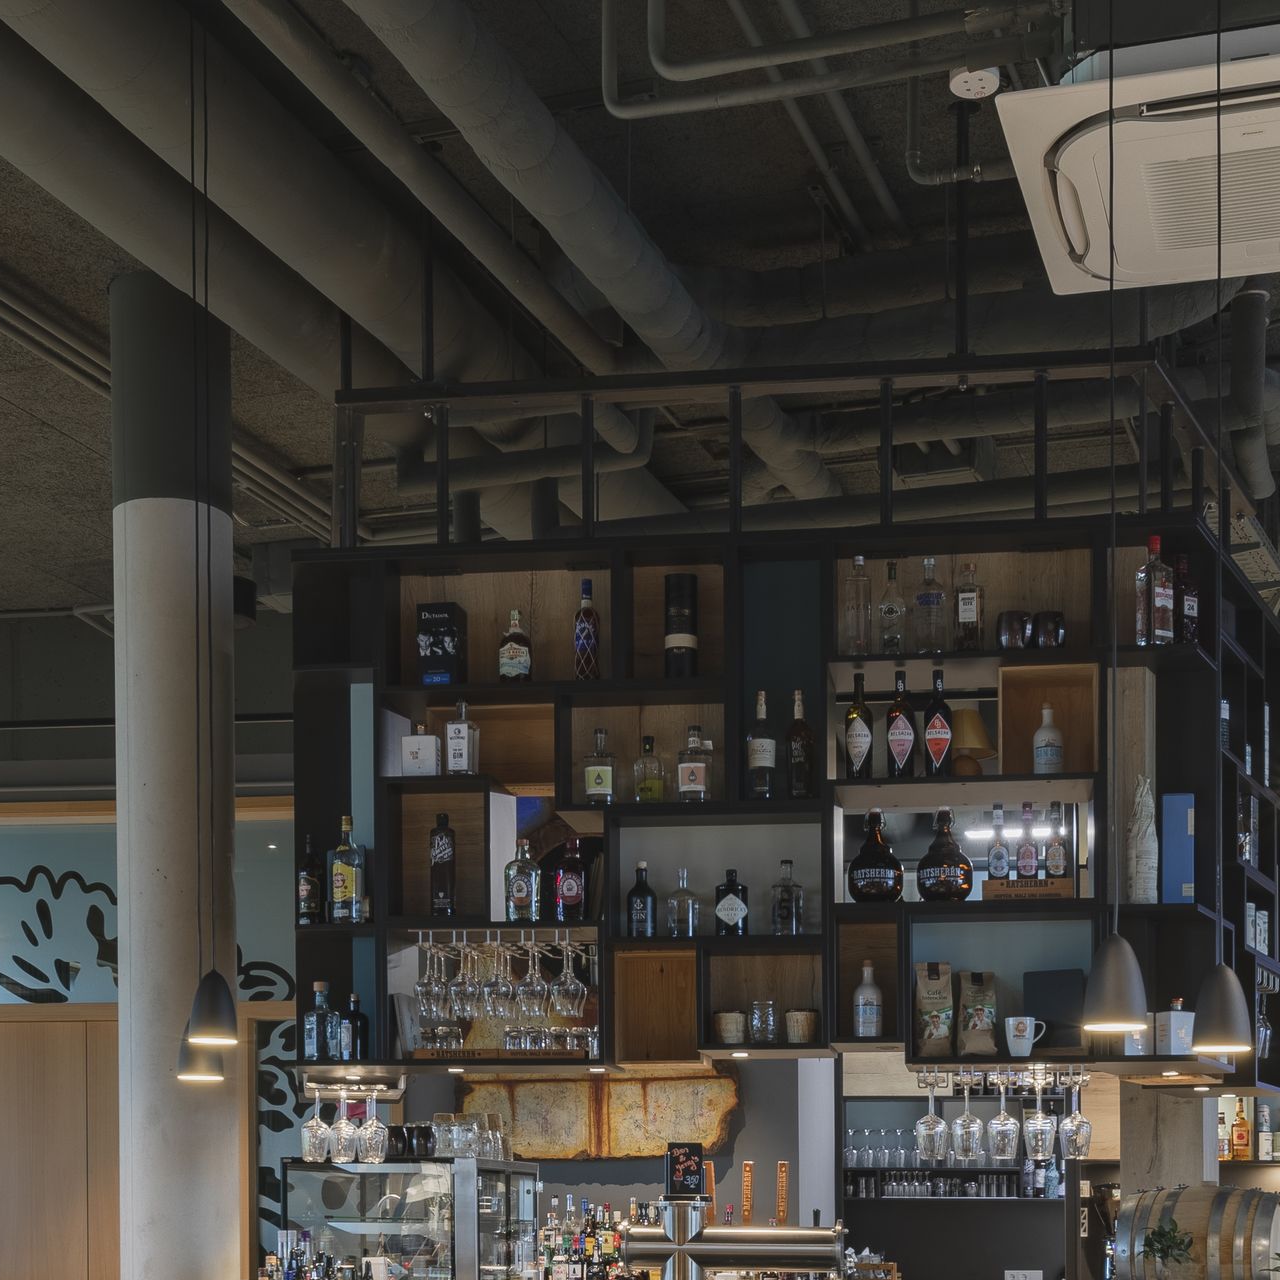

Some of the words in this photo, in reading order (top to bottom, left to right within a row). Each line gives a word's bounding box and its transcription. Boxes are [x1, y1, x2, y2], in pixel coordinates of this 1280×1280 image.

[452, 752, 463, 760] GIN
[853, 868, 895, 879] RATSHERRN
[920, 867, 960, 879] RATSHERRN
[1006, 880, 1049, 888] RATSHERRN
[743, 1172, 752, 1210] RATSHERRN
[779, 1172, 788, 1210] RATSHERRN
